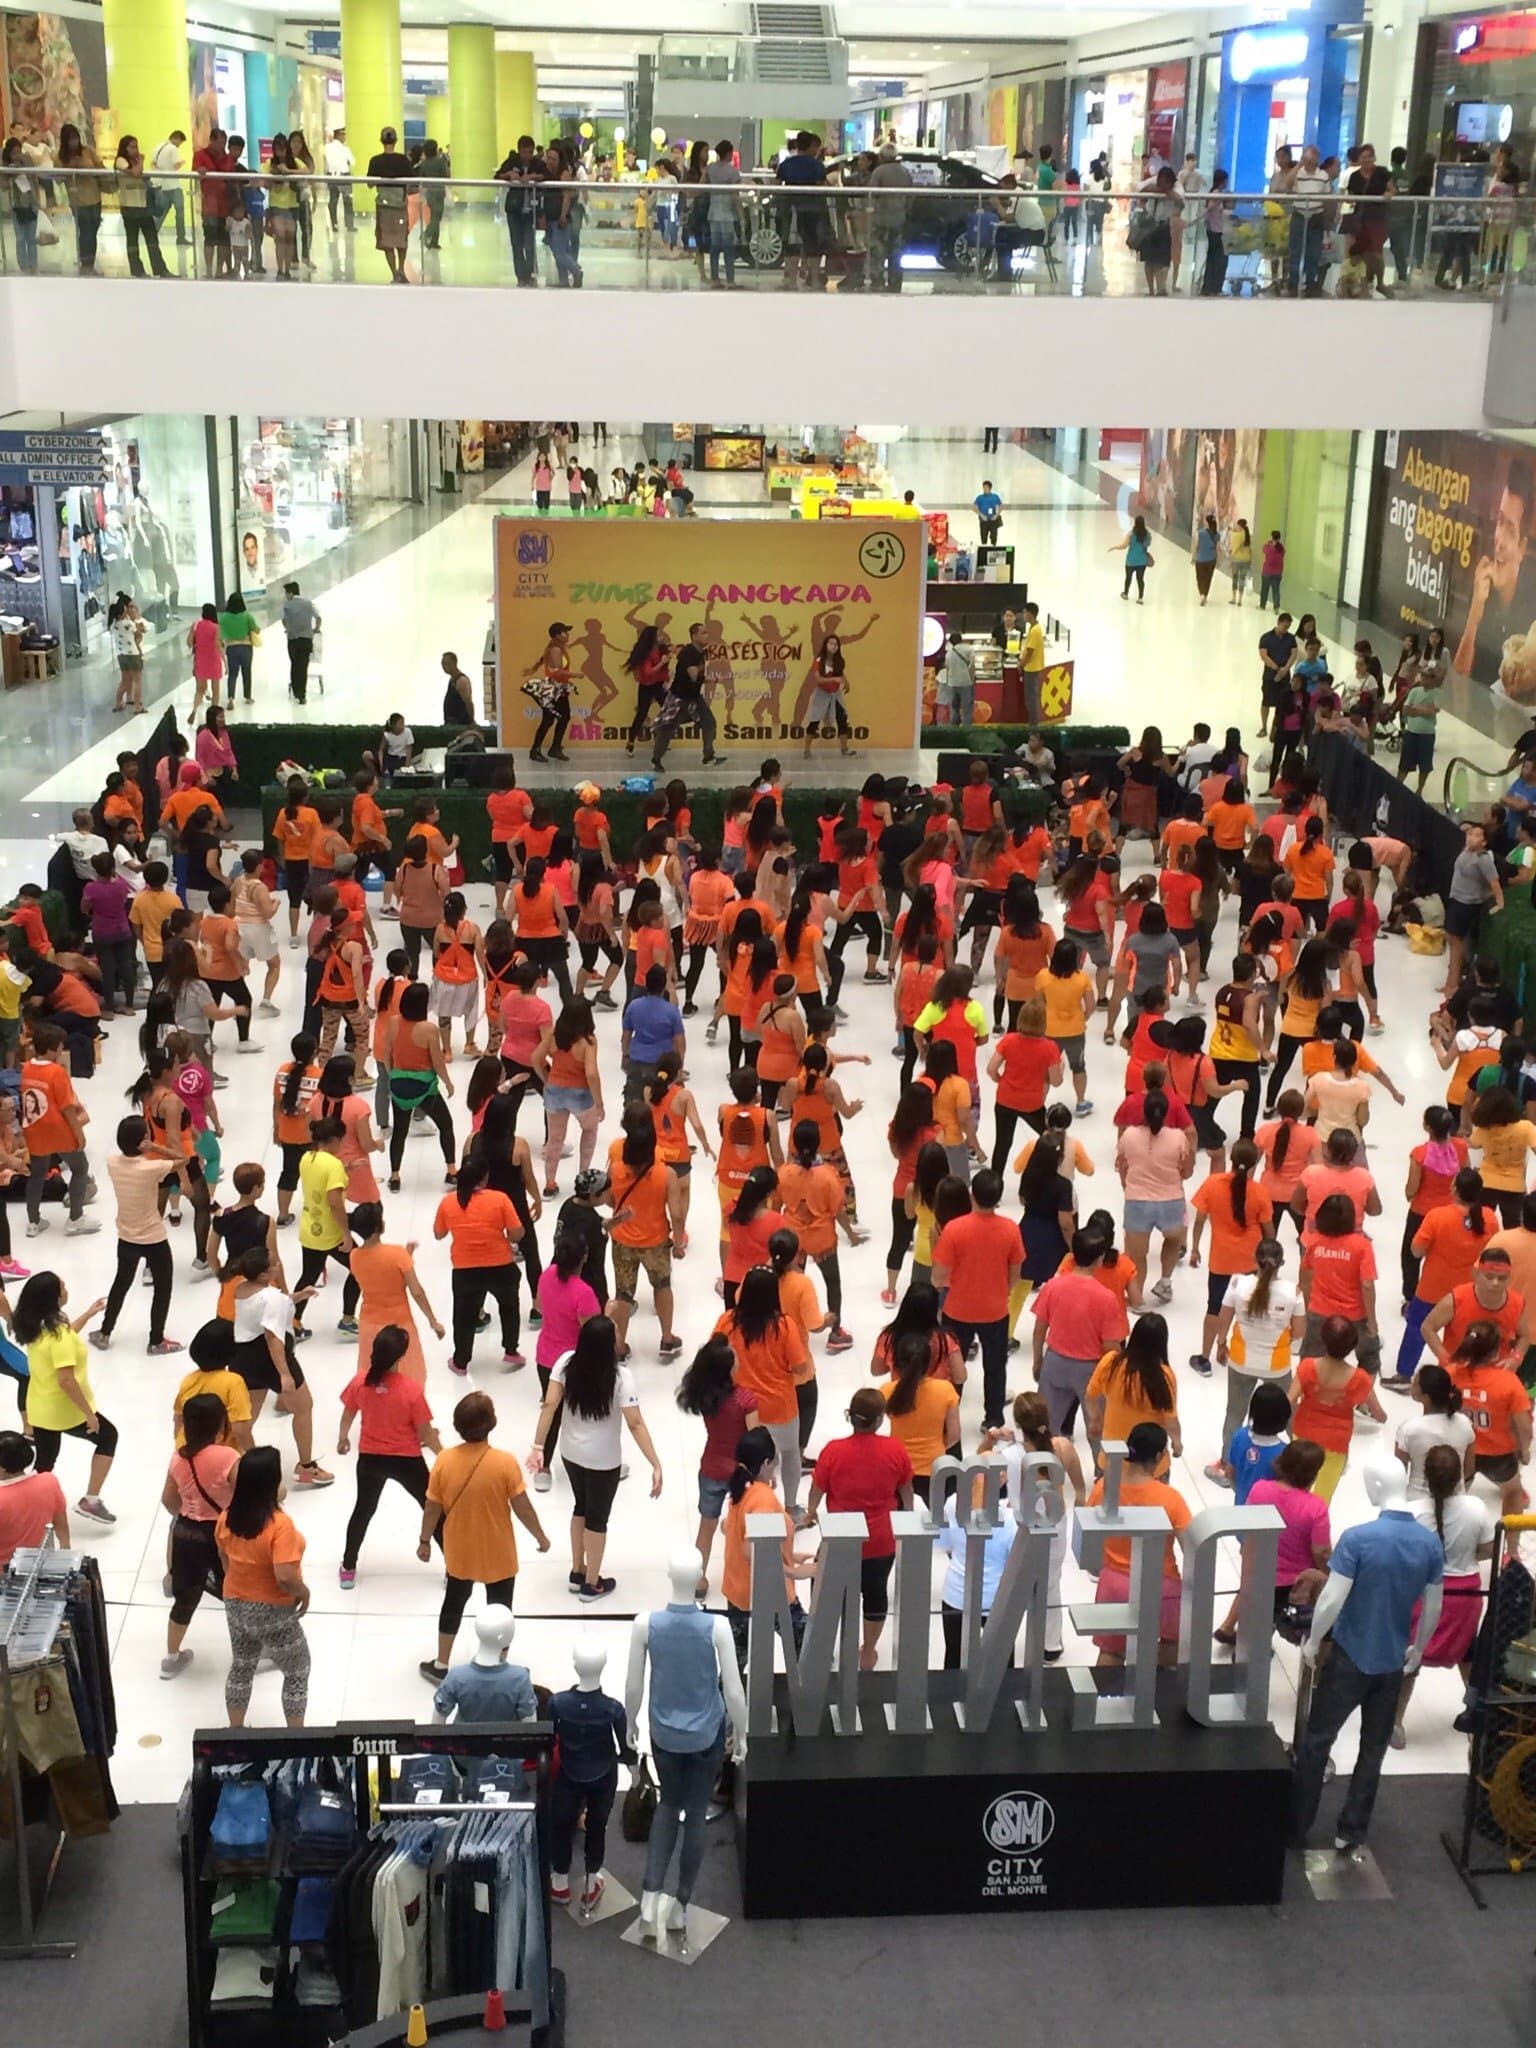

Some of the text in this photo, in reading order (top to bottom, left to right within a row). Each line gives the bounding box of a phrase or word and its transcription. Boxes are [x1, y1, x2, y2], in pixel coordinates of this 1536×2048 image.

[29, 436, 94, 447] CYBERZONE
[20, 454, 53, 464] ADMIN
[56, 454, 94, 465] OFFICE
[43, 471, 94, 481] ELEVATOR
[1402, 446, 1470, 510] Abangan
[1389, 495, 1474, 568] ang bagong
[518, 573, 549, 584] CITY
[1406, 546, 1443, 600] bida!
[723, 724, 773, 740] San
[352, 1736, 398, 1755] bum
[990, 1799, 1044, 1847] SM
[987, 1858, 1043, 1875] CITY
[987, 1875, 1043, 1886] SAN JOSE
[982, 1885, 1048, 1896] DEL MONTE
